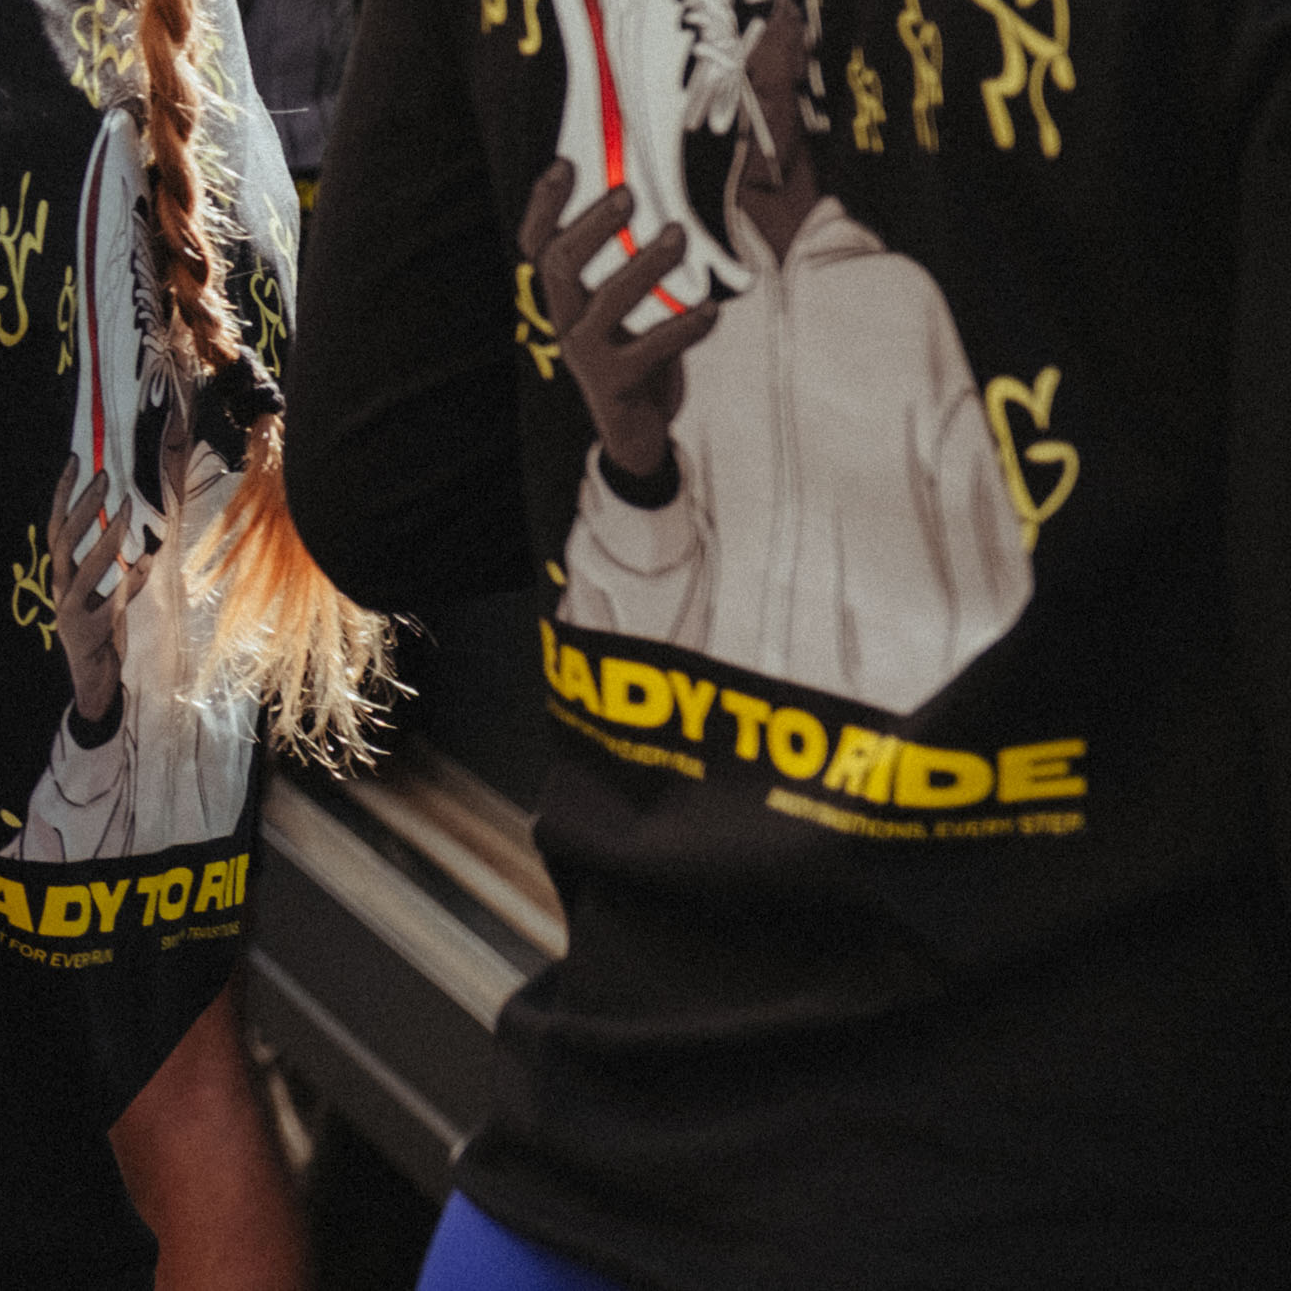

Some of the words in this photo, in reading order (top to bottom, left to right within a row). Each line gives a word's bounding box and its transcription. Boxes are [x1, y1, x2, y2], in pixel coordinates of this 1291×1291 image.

[720, 688, 829, 780] TO
[822, 722, 1088, 809] RIDE
[136, 867, 194, 927] TO
[9, 938, 47, 965] FOR
